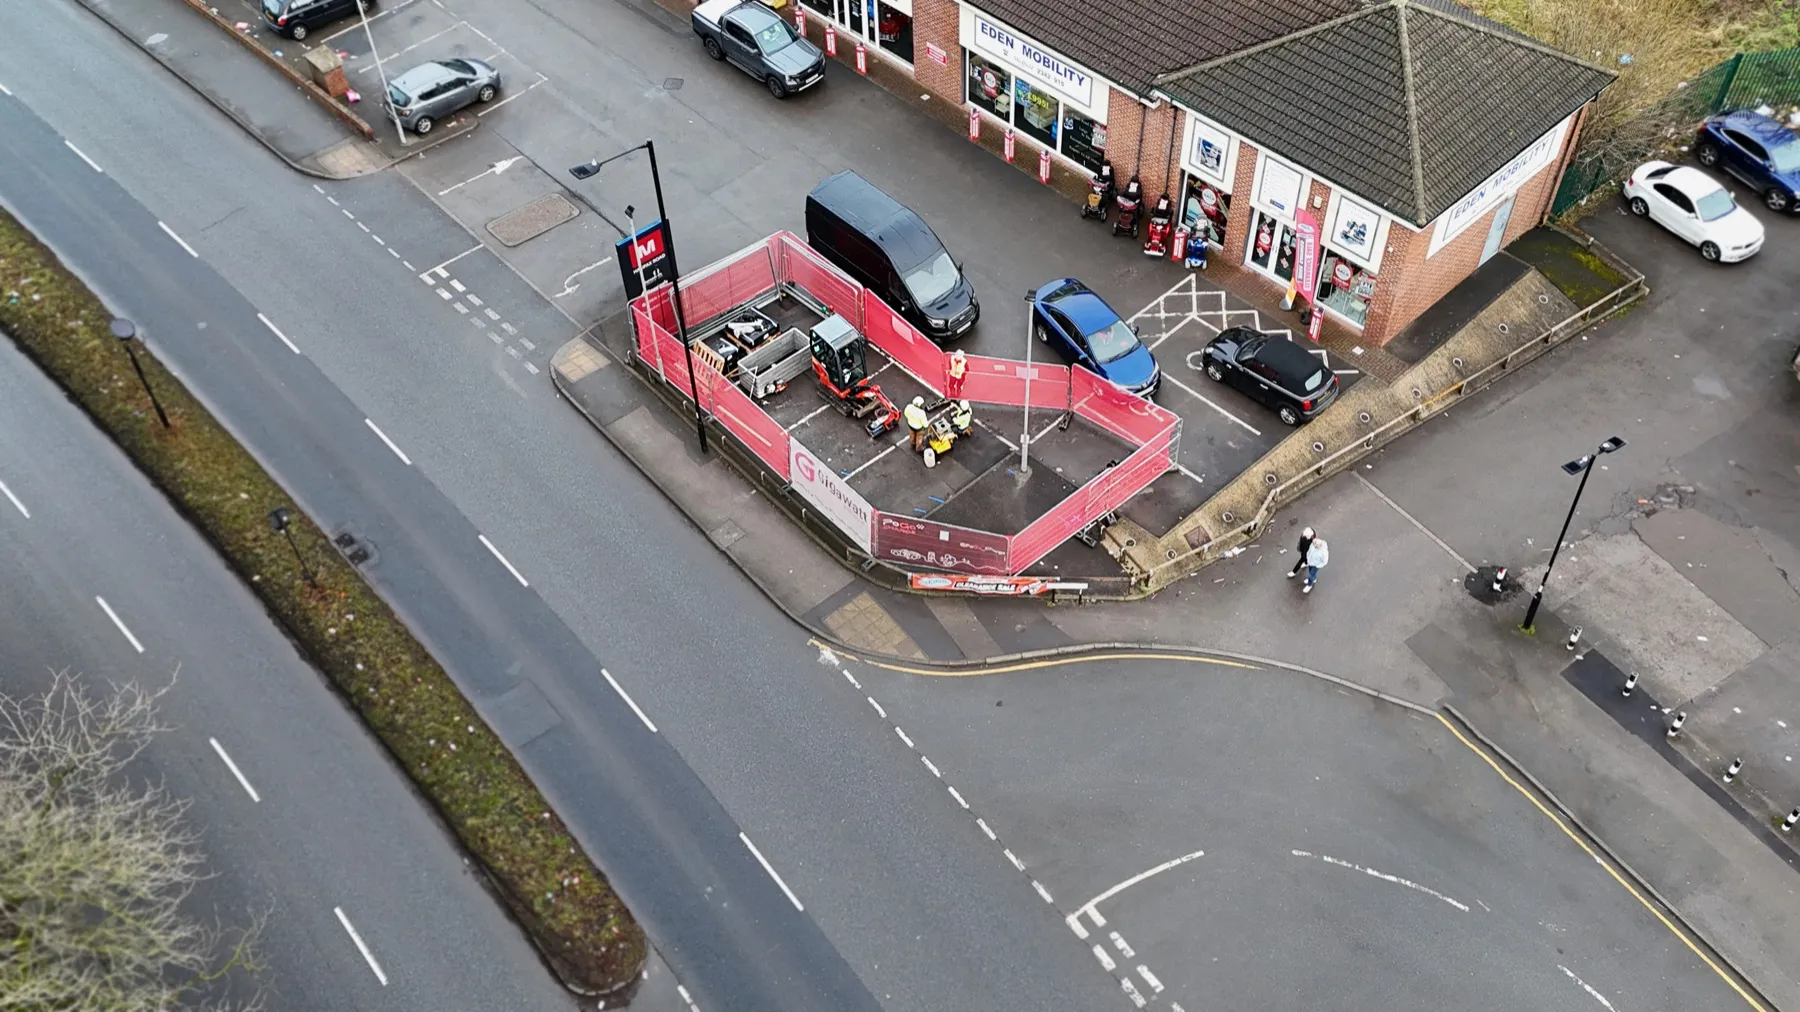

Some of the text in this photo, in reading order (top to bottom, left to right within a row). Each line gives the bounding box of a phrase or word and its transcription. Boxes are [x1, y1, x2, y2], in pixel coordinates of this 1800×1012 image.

[981, 22, 1085, 87] EDEN MOBILITY
[1454, 141, 1547, 219] EDEN MOBILITY
[817, 468, 868, 524] Gigawatt
